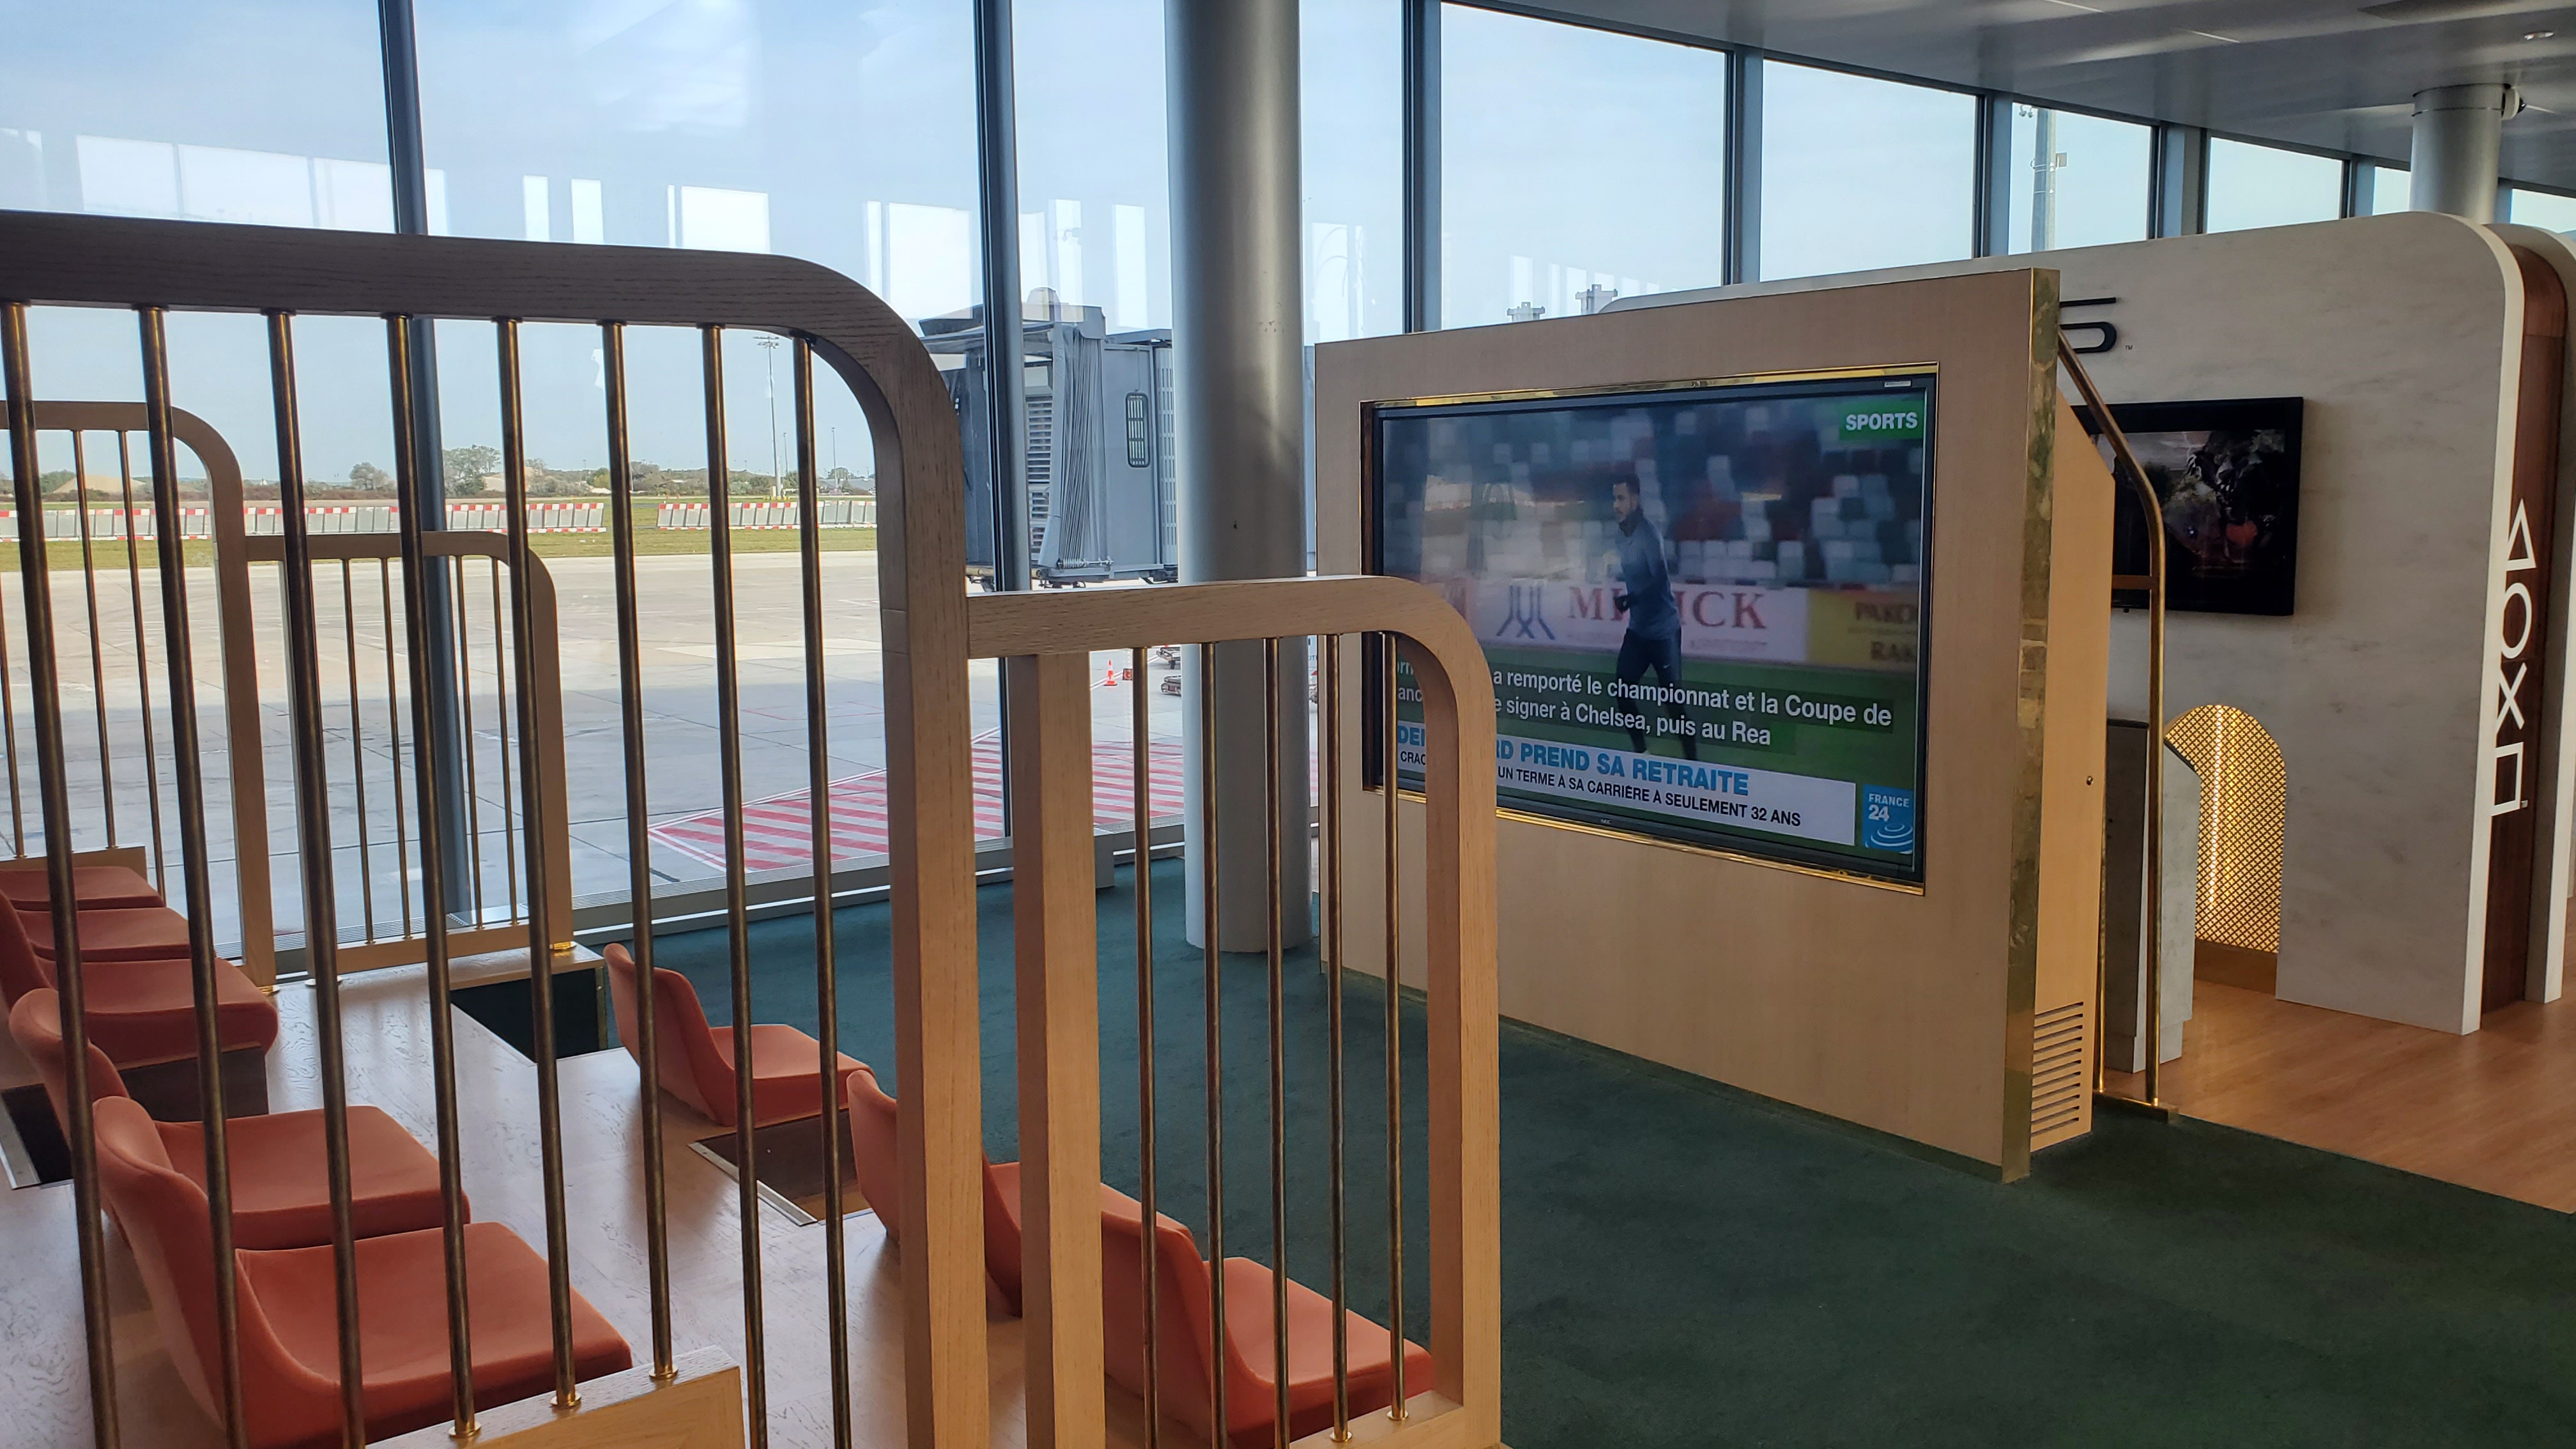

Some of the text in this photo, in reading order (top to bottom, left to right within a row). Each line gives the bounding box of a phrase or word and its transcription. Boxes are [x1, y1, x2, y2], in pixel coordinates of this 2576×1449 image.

[1846, 412, 1917, 431] SPORTS
[1494, 671, 1502, 684] a
[1507, 673, 1582, 693] remporté
[1588, 675, 1602, 695] le
[1607, 678, 1729, 709] championnat
[1735, 692, 1755, 712] et
[1761, 692, 1779, 714] la
[1785, 694, 1856, 725] Coupe
[1864, 703, 1892, 726] de
[1507, 696, 1556, 719] signer
[1560, 701, 1570, 721] à
[1575, 703, 1650, 734] Chelsea,
[1657, 715, 1696, 736] puis
[1702, 722, 1725, 740] au
[1732, 721, 1771, 746] Rea
[1521, 742, 1590, 771] PREND
[1597, 753, 1625, 778] SA
[1632, 758, 1749, 797] RETRAITE
[1498, 766, 1514, 780] UN
[1517, 769, 1554, 786] TERME
[1568, 777, 1584, 792] SA
[1665, 792, 1747, 818] SEULEMENT
[1751, 806, 1767, 821] 32
[1770, 809, 1801, 827] ANS
[1868, 793, 1910, 808] FRANCE
[1868, 804, 1890, 822] 24
